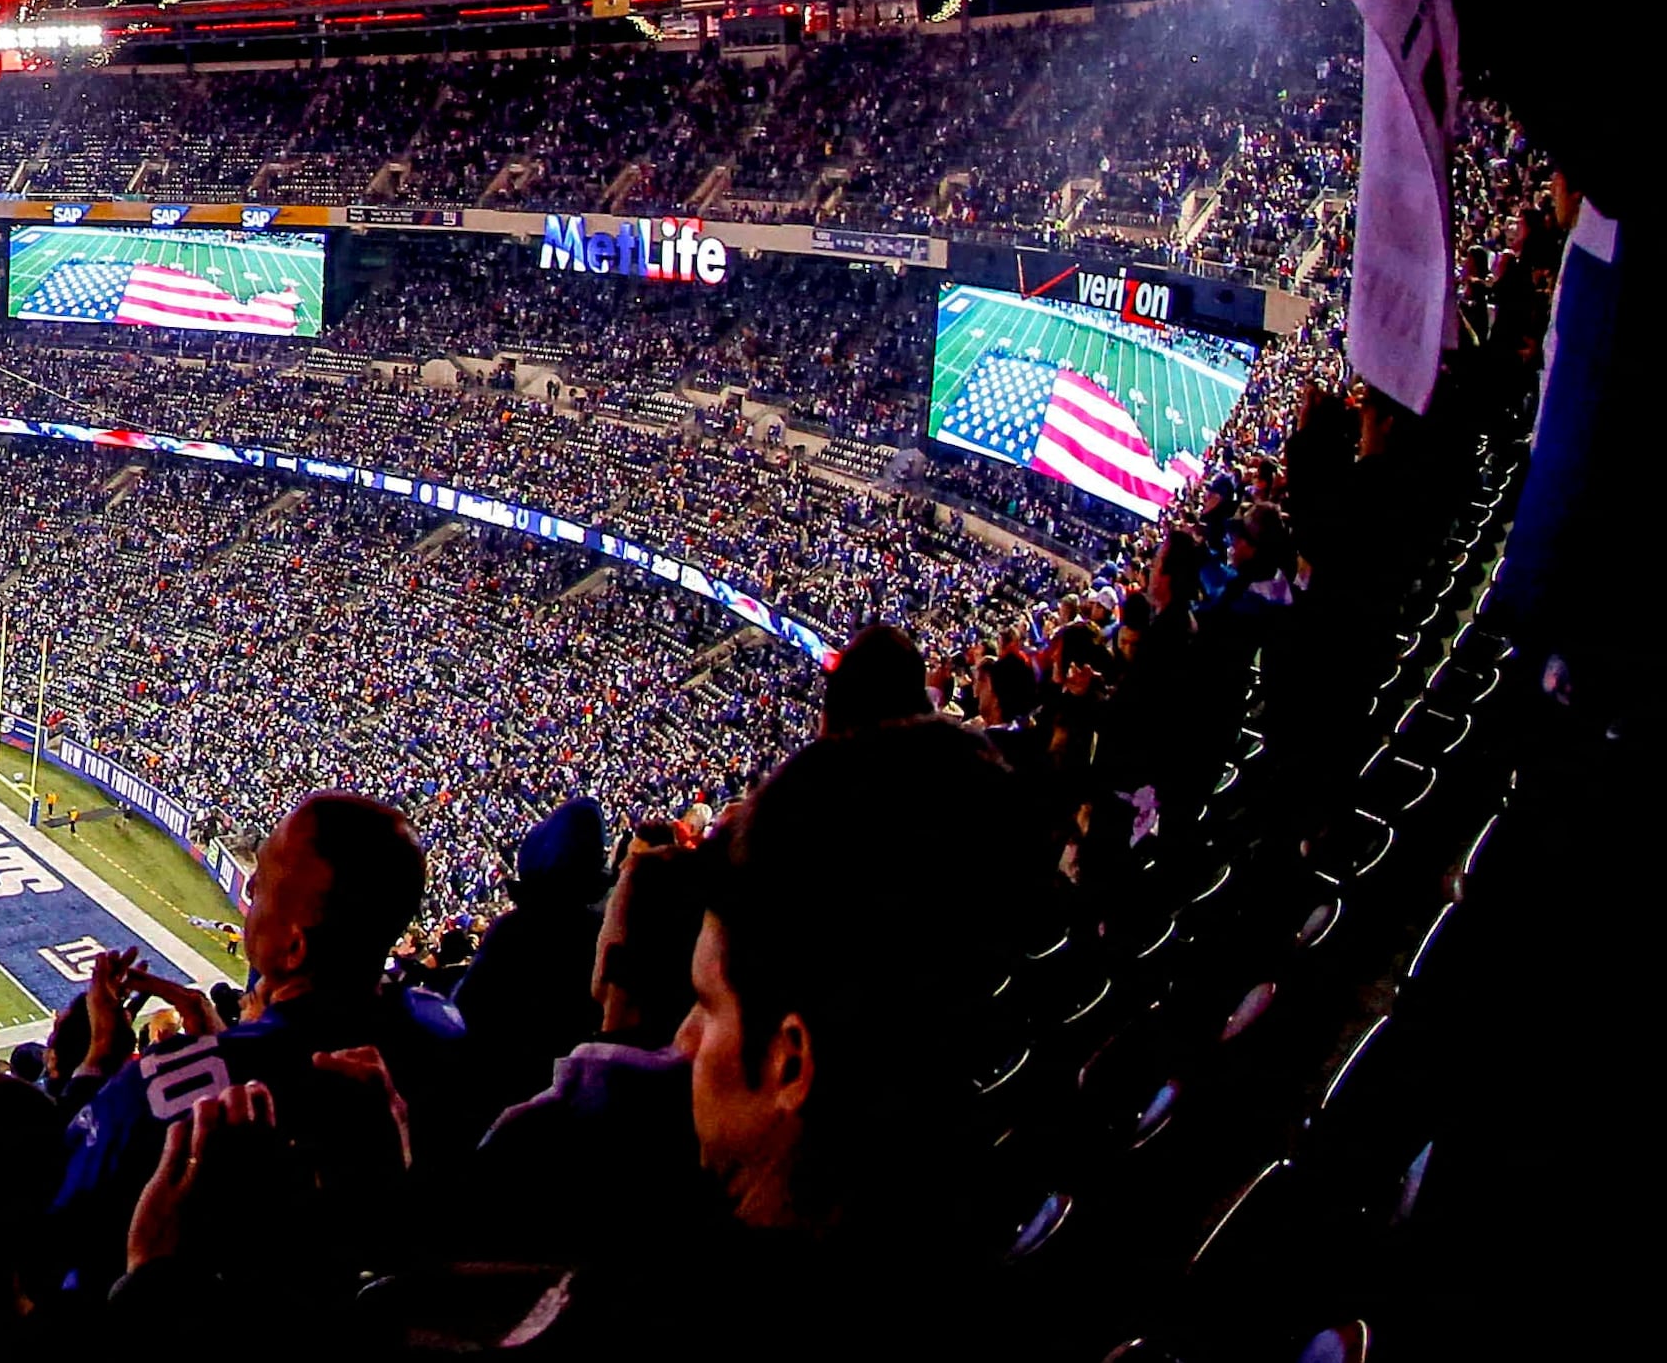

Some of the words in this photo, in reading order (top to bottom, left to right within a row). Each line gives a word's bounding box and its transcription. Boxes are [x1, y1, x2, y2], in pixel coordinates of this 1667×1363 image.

[52, 205, 83, 223] SAP
[151, 208, 181, 226] SAP
[241, 209, 271, 228] SAP
[539, 214, 727, 285] MetLife
[1077, 267, 1168, 330] verizon
[61, 740, 84, 769] NEW
[83, 752, 112, 785] YORK
[110, 767, 155, 813] FOOTBALL
[155, 797, 186, 837] GIANTS
[140, 1035, 231, 1121] 10
